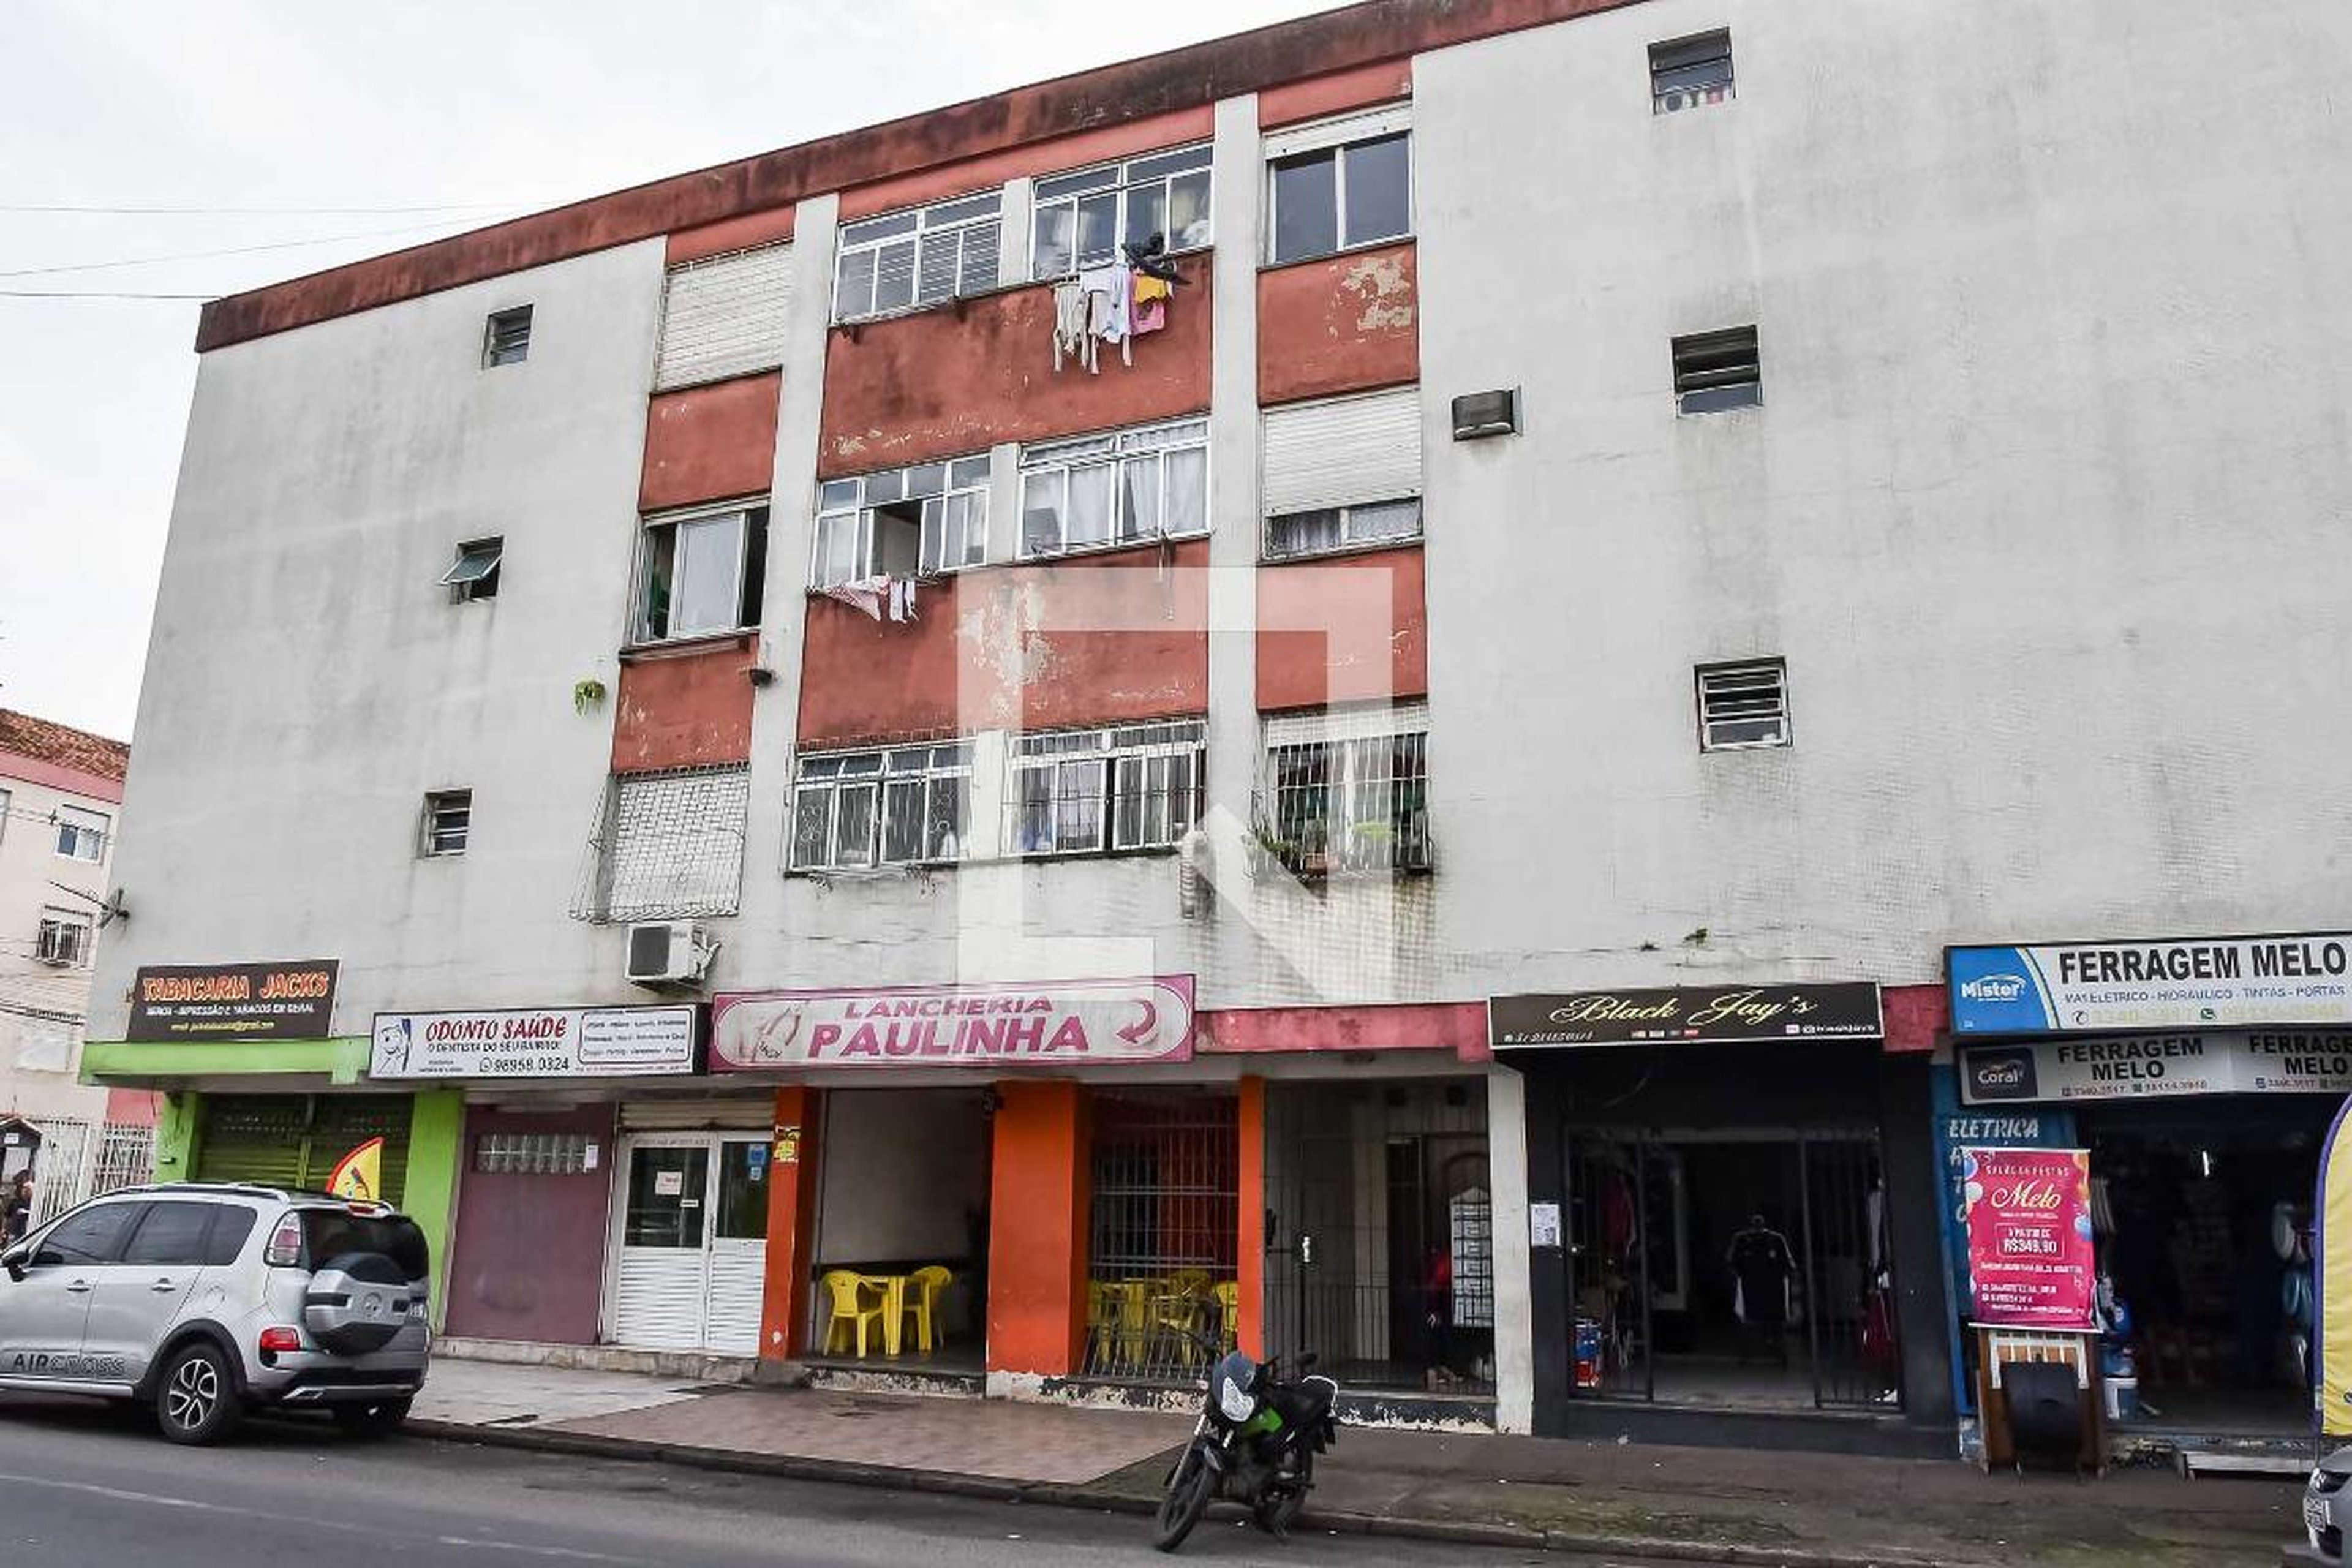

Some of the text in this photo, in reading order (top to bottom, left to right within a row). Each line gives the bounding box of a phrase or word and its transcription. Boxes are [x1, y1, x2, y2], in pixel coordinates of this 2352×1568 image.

[2059, 942, 2347, 984] FERRAGEM MELO
[142, 971, 329, 1001] TABACARIA JACKS
[1961, 981, 2020, 998] Mister
[2242, 987, 2286, 998] TINTAS
[2296, 985, 2345, 997] PORTAS
[845, 995, 1054, 1019] LANCHERIA
[1549, 989, 1819, 1027] Black Jay's
[426, 1012, 567, 1042] ODONTO SAÚDE
[807, 1016, 1090, 1059] PAULINHA
[483, 1042, 497, 1052] DO
[2058, 1037, 2204, 1065] FERRAGEM
[2249, 1035, 2352, 1054] FERRAGE
[1978, 1069, 2018, 1084] Coral
[2092, 1060, 2165, 1080] MELO
[2285, 1057, 2348, 1074] MELO
[1949, 1118, 2040, 1139] ELETRICA
[1991, 1179, 2061, 1209] Melo
[13, 1354, 125, 1376] AIRCROSS
